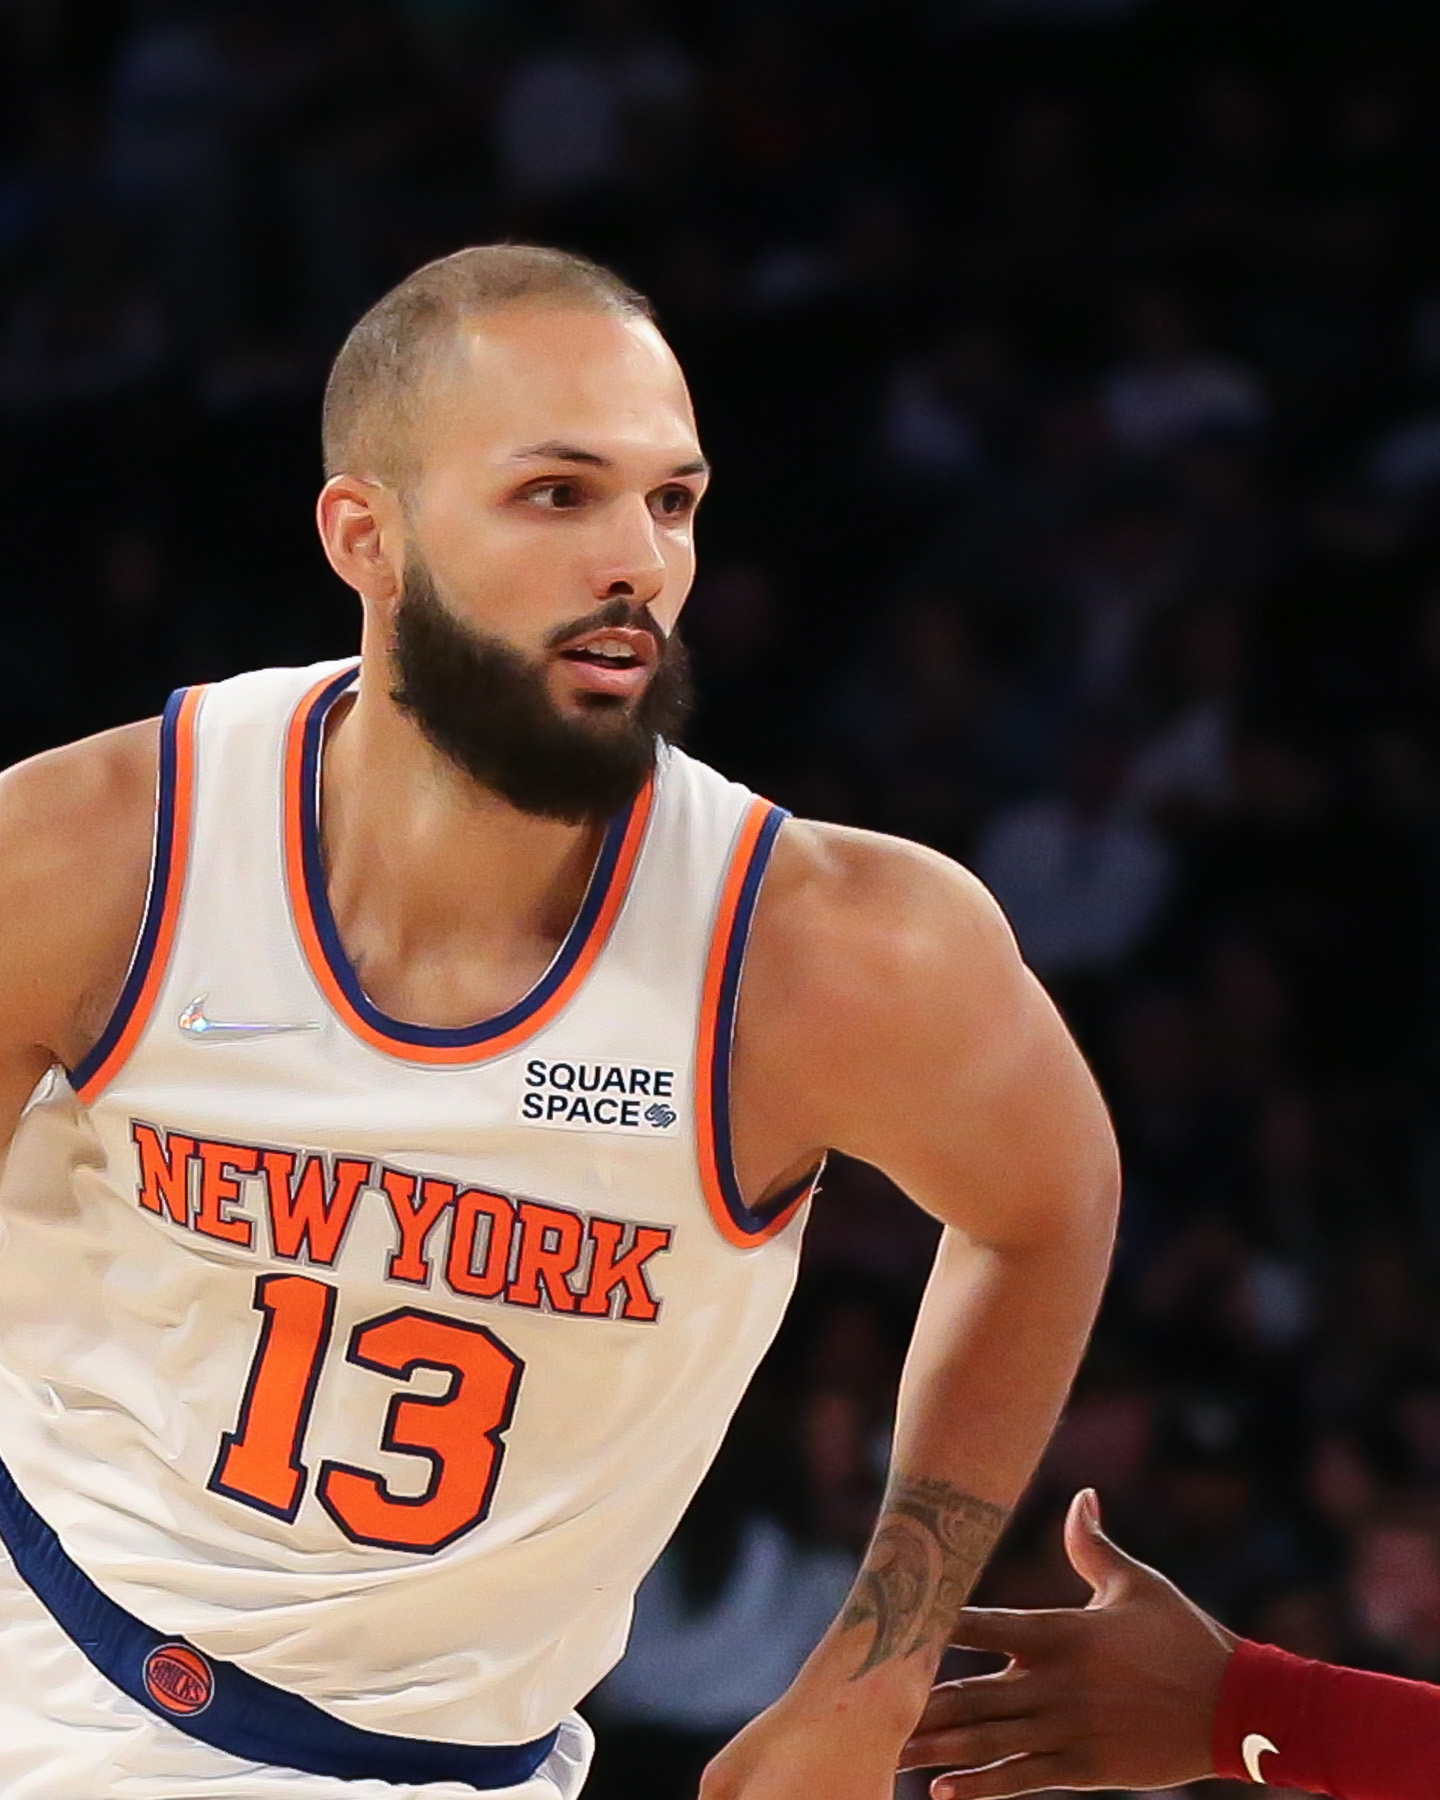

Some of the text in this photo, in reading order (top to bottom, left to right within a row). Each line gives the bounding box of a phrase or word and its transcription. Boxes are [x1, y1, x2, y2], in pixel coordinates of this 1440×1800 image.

[522, 1092, 641, 1126] SPACE
[524, 1060, 674, 1097] SQUARE
[130, 1118, 676, 1323] NEW YORK
[207, 1273, 525, 1555] 13
